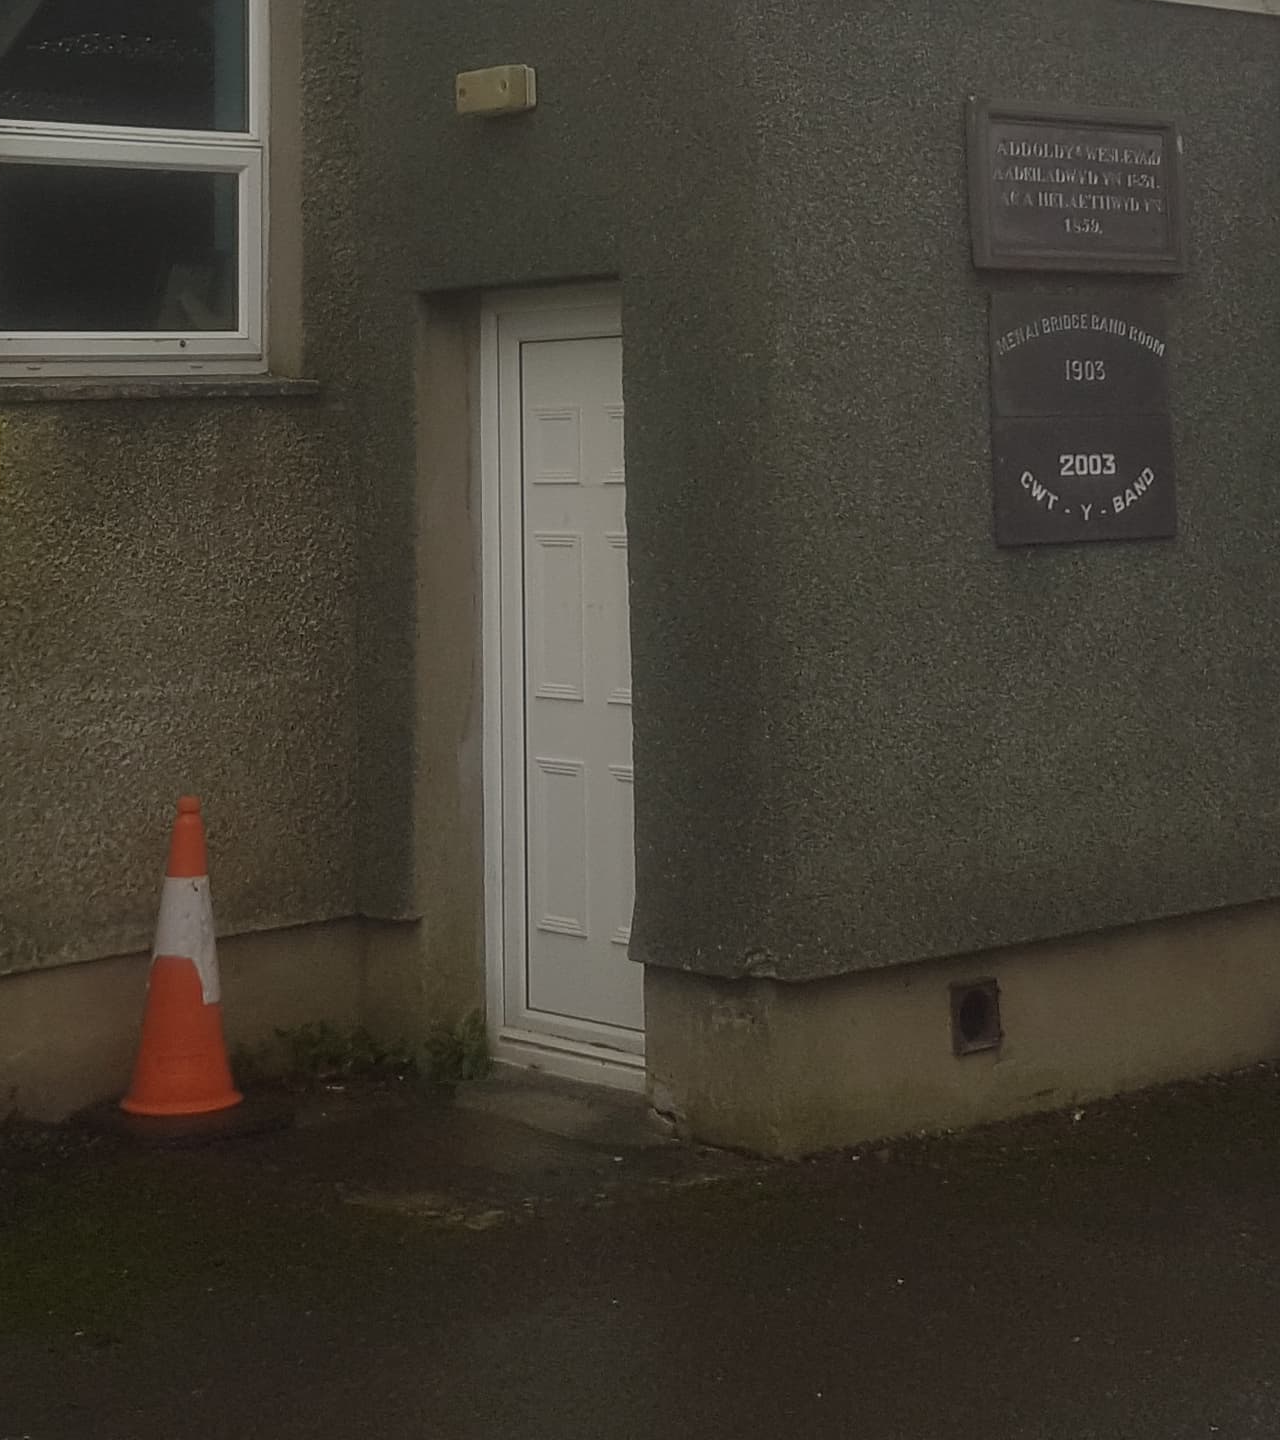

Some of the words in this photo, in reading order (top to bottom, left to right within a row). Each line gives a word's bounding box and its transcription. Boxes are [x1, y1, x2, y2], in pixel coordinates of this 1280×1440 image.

[996, 320, 1039, 356] MENAI
[1040, 313, 1089, 335] BRIDGE
[1090, 313, 1126, 337] BAND
[1127, 325, 1166, 358] ROOM
[1064, 359, 1106, 381] 1903
[1059, 453, 1117, 477] 2003
[1020, 470, 1059, 511] CWT
[1079, 503, 1093, 521] Y
[1111, 466, 1155, 514] BAND
